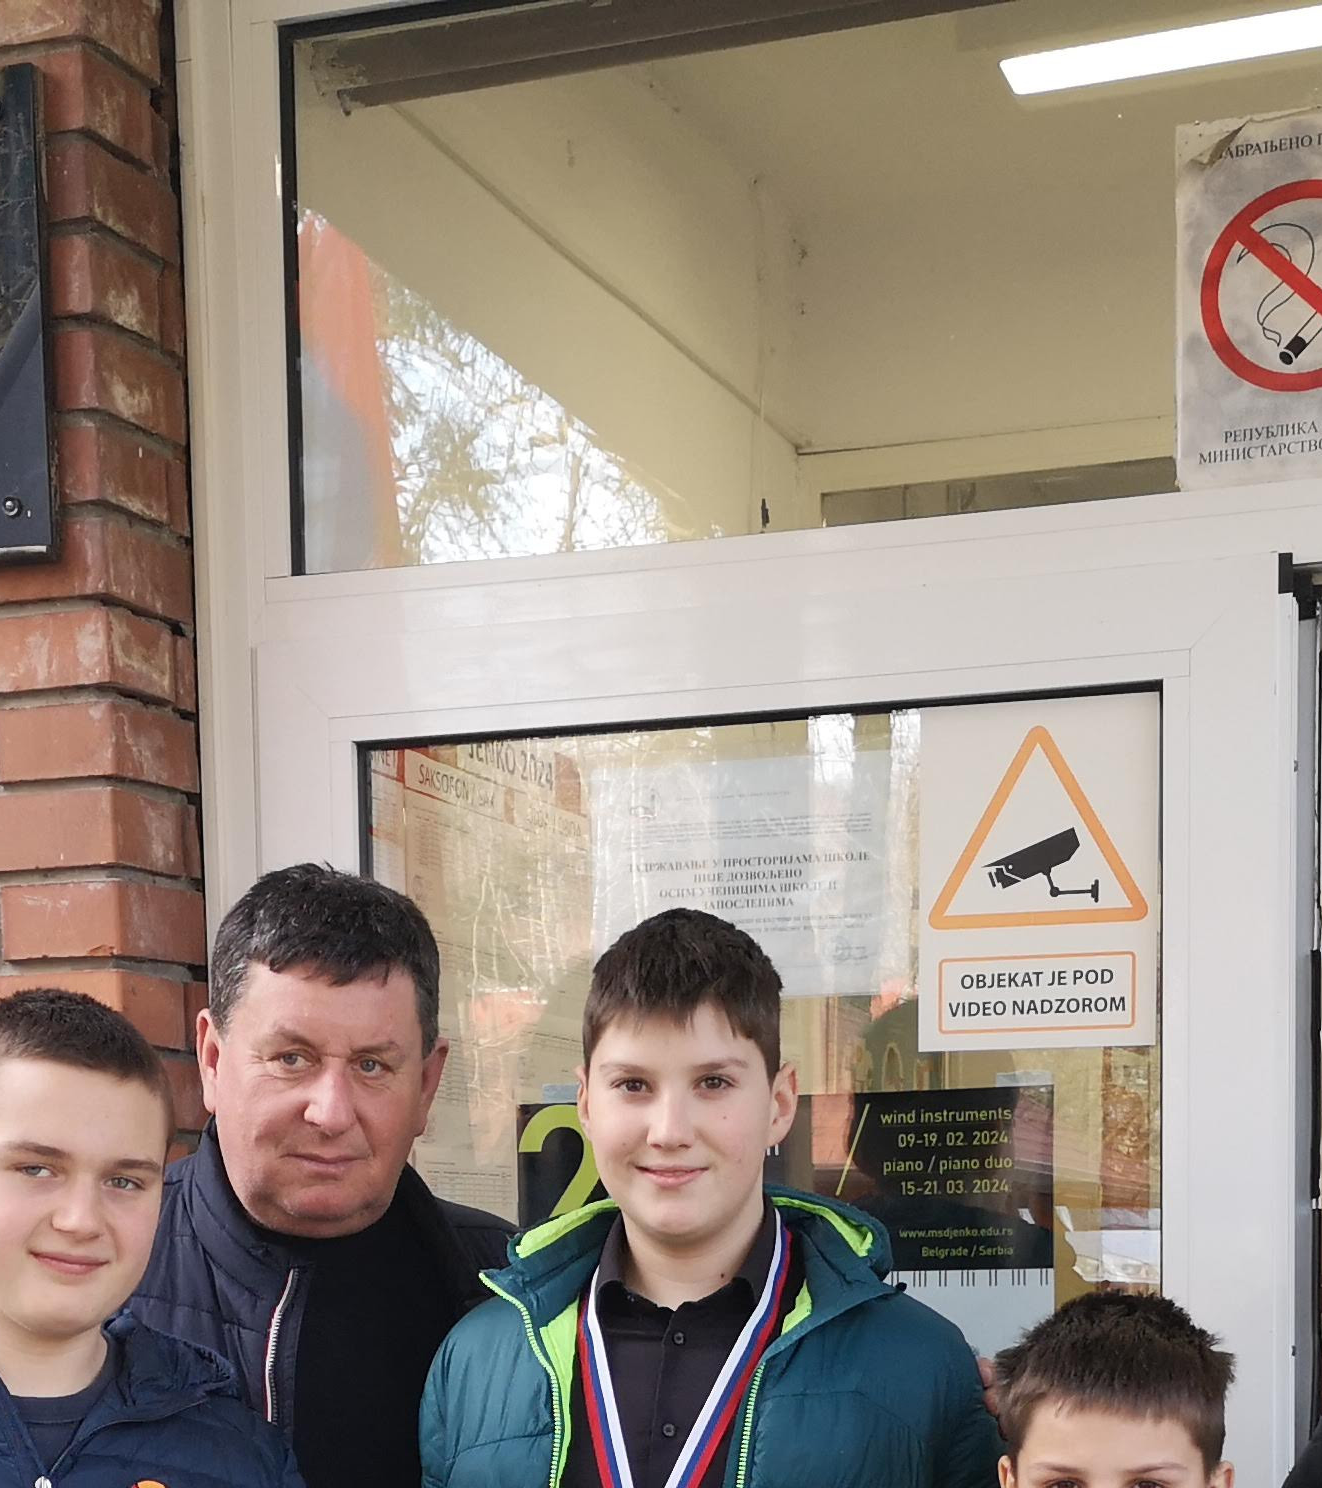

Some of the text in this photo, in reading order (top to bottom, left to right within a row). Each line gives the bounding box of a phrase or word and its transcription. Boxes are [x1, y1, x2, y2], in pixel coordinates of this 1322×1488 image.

[1213, 134, 1313, 160] АБРАЊЕНО
[1223, 420, 1319, 444] РЕПУБЛИКА
[960, 968, 1114, 990] OBJEKAT JE POD
[948, 996, 1126, 1018] VIDEO NADZOROM
[880, 1107, 1013, 1125] wind instruments
[897, 1132, 942, 1148] 09-19.
[945, 1131, 968, 1147] 02.
[883, 1158, 924, 1175] piano
[939, 1157, 980, 1175] piano
[984, 1154, 1013, 1170] duo
[900, 1180, 943, 1196] 15-21.
[945, 1179, 967, 1195] 03.
[898, 1226, 1014, 1242] www.msdjenko.edu.rs
[921, 1246, 969, 1259] Belgrade
[979, 1244, 1014, 1257] Serbia
